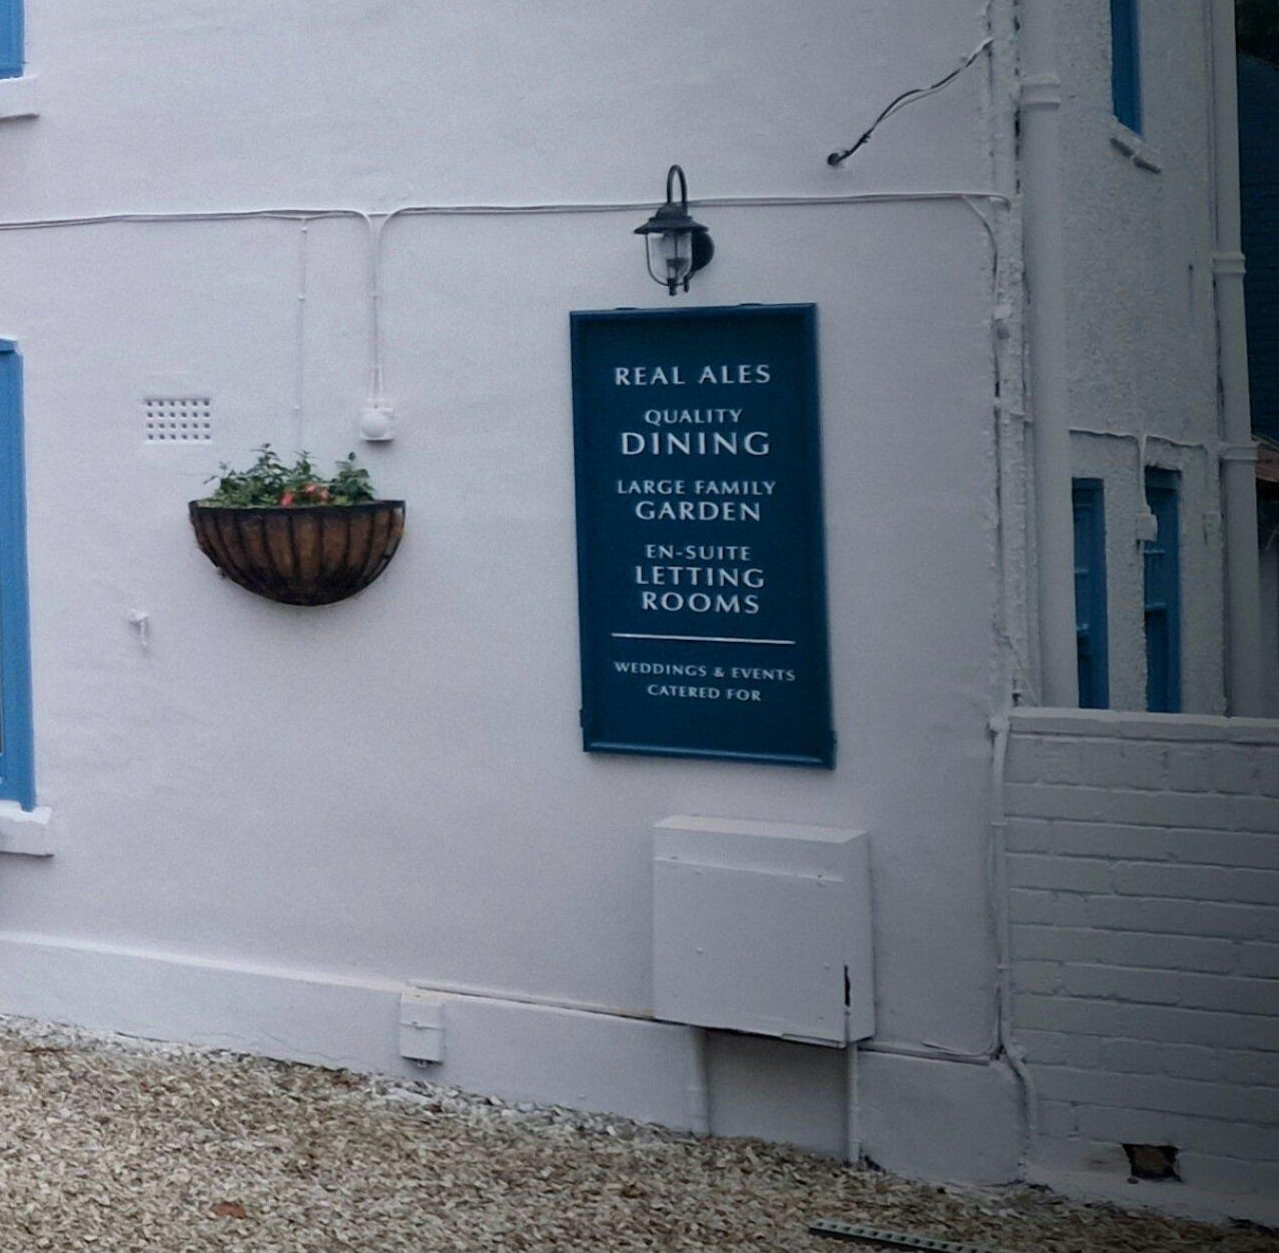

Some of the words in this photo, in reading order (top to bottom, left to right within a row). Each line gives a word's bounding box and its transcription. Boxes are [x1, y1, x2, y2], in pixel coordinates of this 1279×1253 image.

[614, 366, 686, 386] REAL
[697, 364, 771, 384] ALES
[644, 408, 742, 426] QUALITY
[621, 431, 770, 456] DINING
[617, 480, 686, 494] LARGE
[694, 480, 776, 495] FAMILY
[635, 501, 761, 522] GARDEN
[645, 544, 751, 561] EN-SUITE
[634, 566, 765, 588] LETTING
[641, 591, 760, 615] ROOMS
[613, 662, 707, 677] WEDDINGS
[713, 667, 725, 678] &
[731, 667, 796, 681] EVENTS
[647, 684, 720, 699] CATERED
[726, 688, 761, 701] FOR
